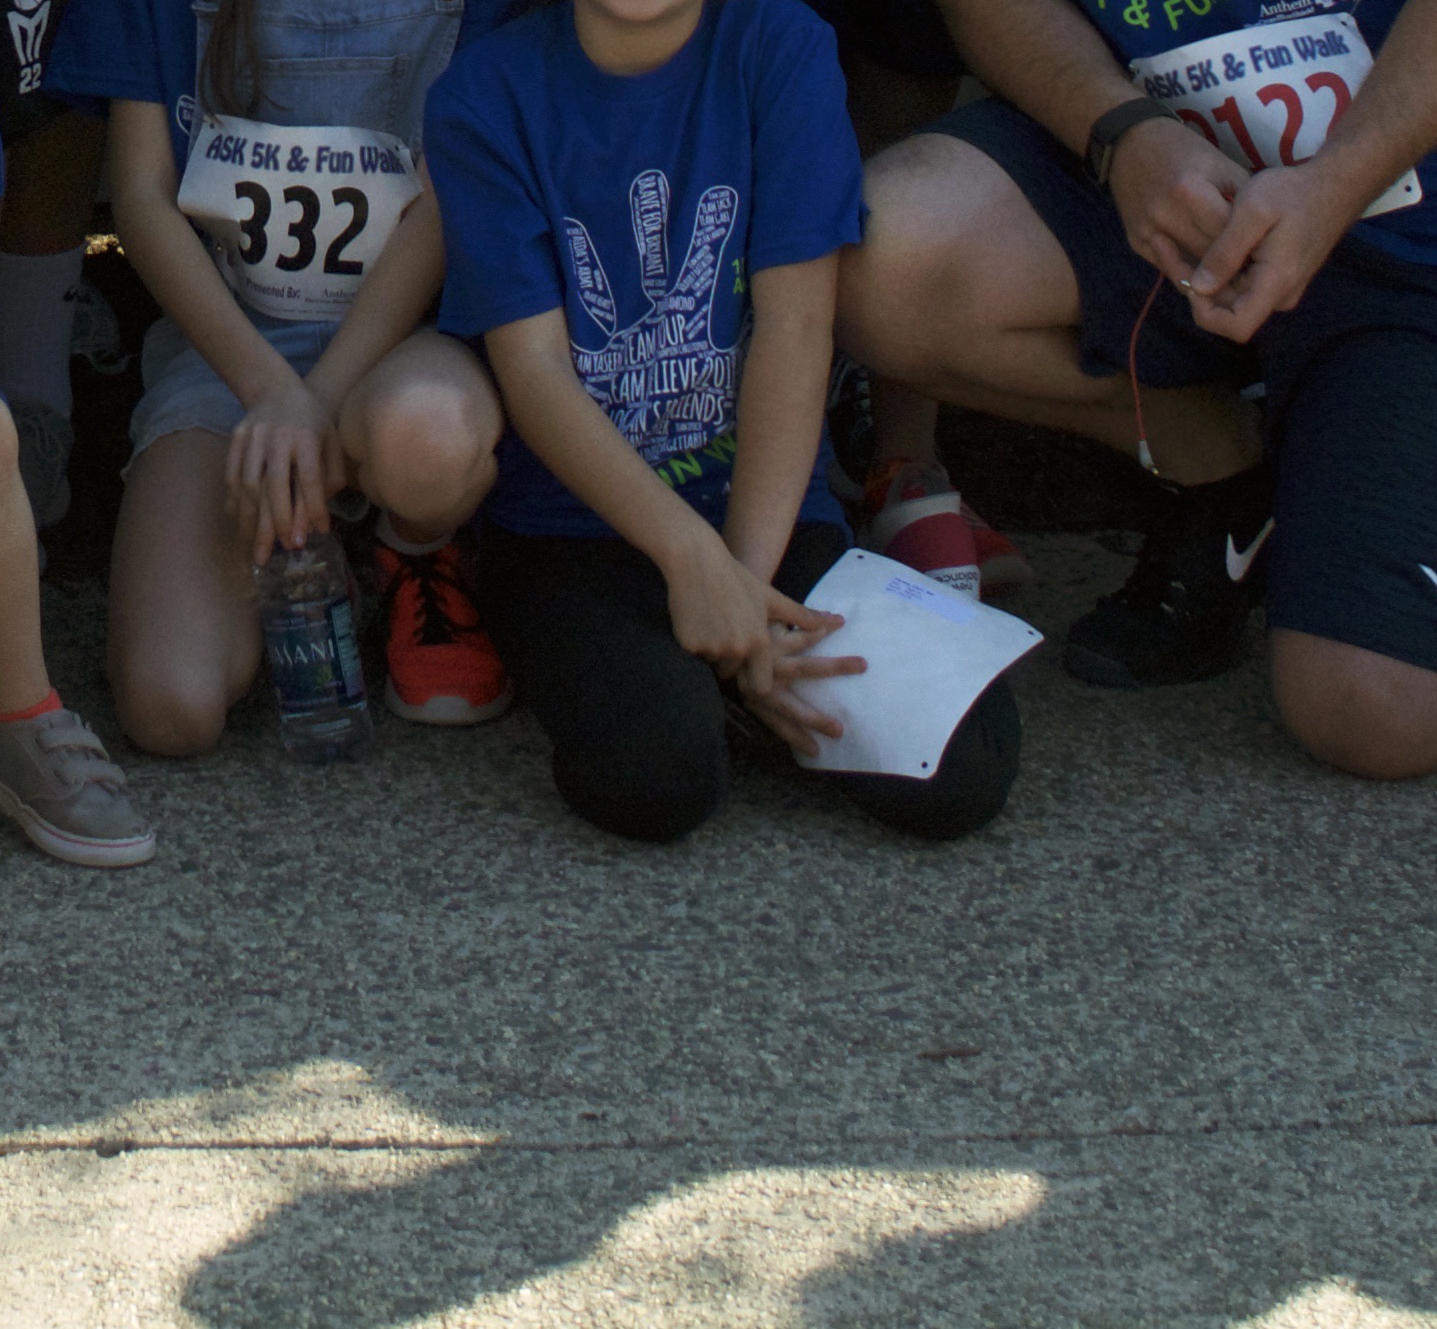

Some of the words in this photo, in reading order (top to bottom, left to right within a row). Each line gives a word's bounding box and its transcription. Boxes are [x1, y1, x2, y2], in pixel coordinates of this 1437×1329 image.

[1186, 59, 1220, 93] 5K
[1221, 52, 1246, 81] &
[1248, 42, 1294, 73] Fun
[1291, 30, 1351, 62] Walk
[206, 133, 247, 167] ASK
[251, 144, 282, 172] 5K
[286, 145, 310, 172] &
[315, 145, 355, 174] Fun
[359, 144, 406, 175] Walk
[234, 180, 370, 276] 332
